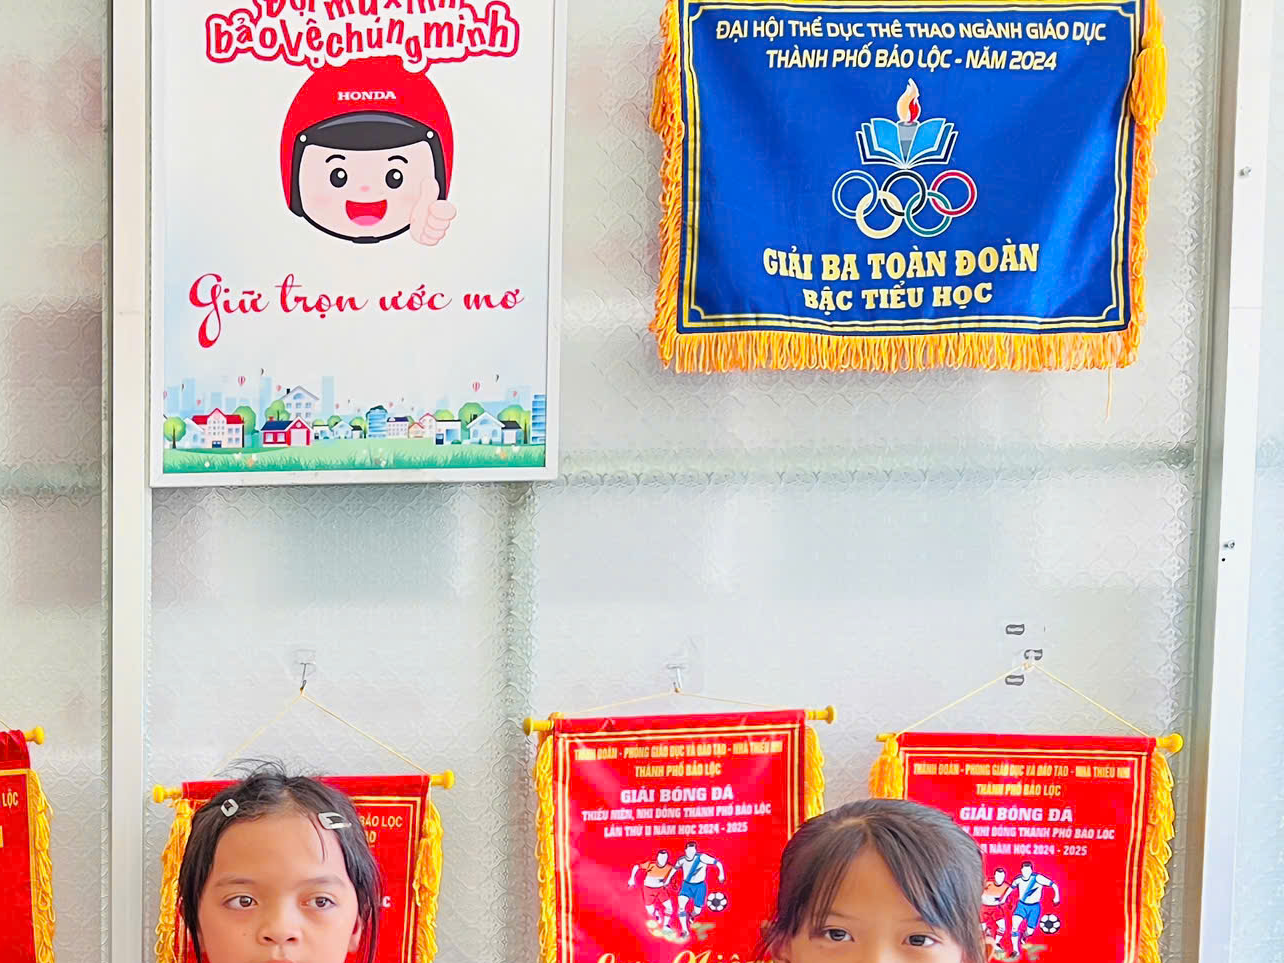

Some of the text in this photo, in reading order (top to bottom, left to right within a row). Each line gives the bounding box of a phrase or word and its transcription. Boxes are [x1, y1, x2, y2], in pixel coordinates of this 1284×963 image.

[326, 17, 422, 63] chúng
[716, 16, 1106, 46] ĐẠI HỘI THỂ DỤC THAO NGÀNH GIÁO DỤC
[766, 41, 1057, 72] THÀNH PHỐ BẢO LỘC NĂM 2024
[337, 91, 396, 100] HONDA
[763, 238, 1039, 281] GIẢI BA TOÀN ĐOÀN
[189, 273, 524, 348] Giữ trọn ước mơ
[802, 280, 993, 315] BẬC TIỂU HỌC
[1, 787, 19, 809] LỘC
[620, 785, 655, 804] GIẢI
[659, 785, 708, 802] BÓNG
[959, 803, 994, 821] GIẢI
[1062, 845, 1088, 856] 2025
